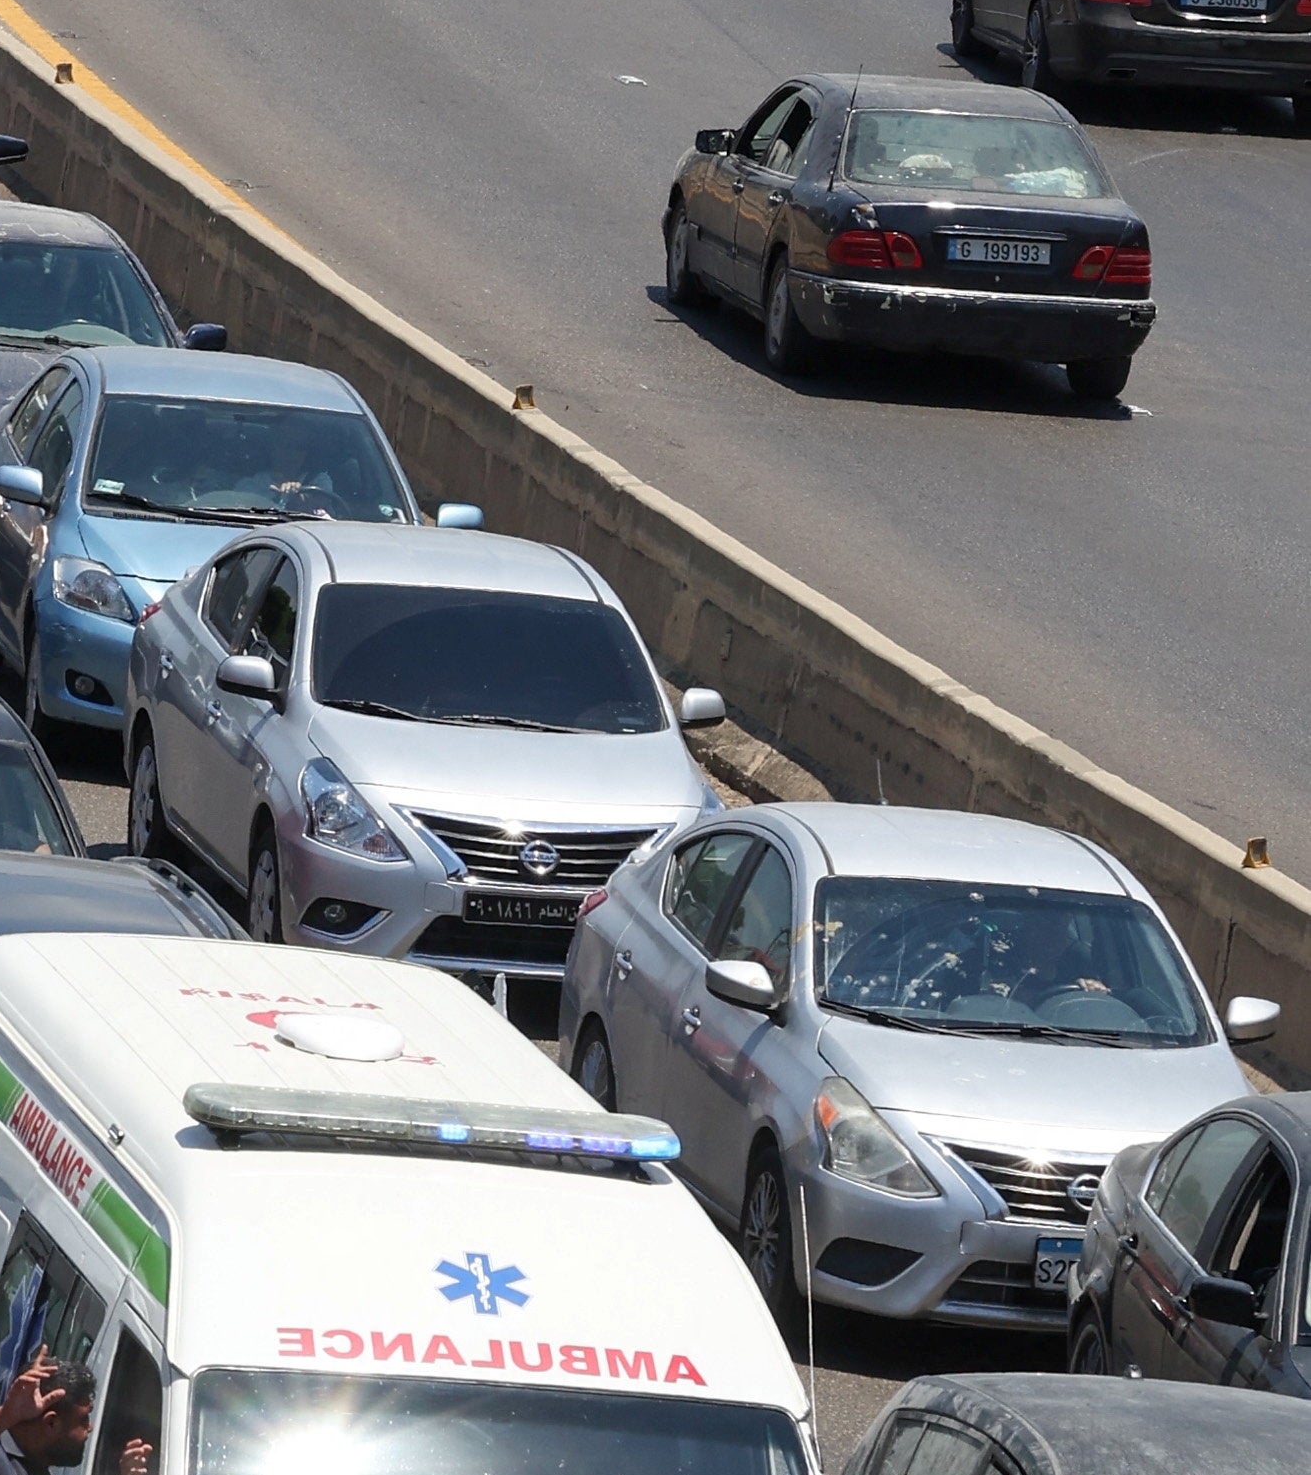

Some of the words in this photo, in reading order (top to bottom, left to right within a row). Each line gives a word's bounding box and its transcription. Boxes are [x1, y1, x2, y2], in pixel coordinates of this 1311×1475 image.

[961, 241, 971, 258] G
[983, 242, 1039, 262] 199193
[476, 900, 532, 919] ٩٠١٨٩٦
[538, 905, 570, 920] العام
[179, 986, 384, 1011] RISALA
[9, 1092, 93, 1208] AMBULANCE
